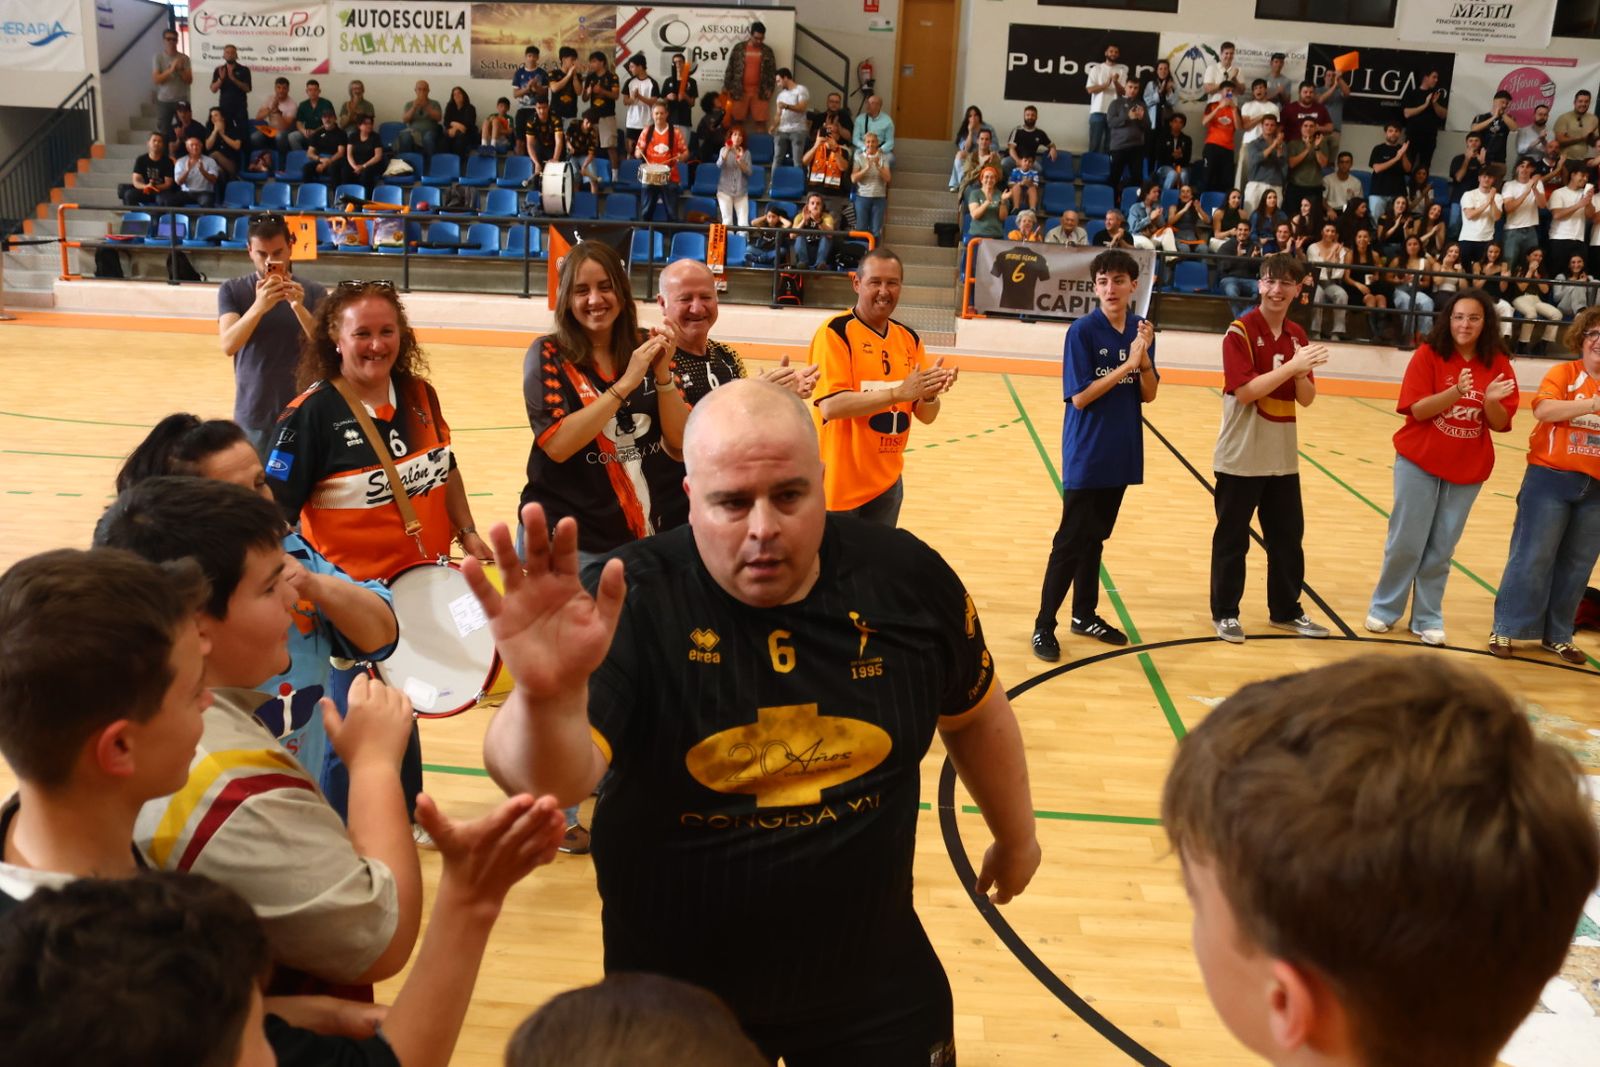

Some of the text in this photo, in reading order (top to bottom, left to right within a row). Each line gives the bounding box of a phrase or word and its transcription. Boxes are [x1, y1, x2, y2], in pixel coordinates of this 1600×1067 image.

[345, 9, 466, 30] AUTOESCUELA
[1451, 4, 1512, 19] MATI
[340, 31, 465, 55] SALAMANCA
[1011, 262, 1025, 283] 6
[706, 361, 720, 389] 6
[882, 350, 891, 376] 6
[389, 428, 408, 458] 6
[768, 629, 797, 674] 6
[851, 664, 883, 680] 1995
[724, 741, 793, 783] 20
[680, 807, 838, 830] CONGESA
